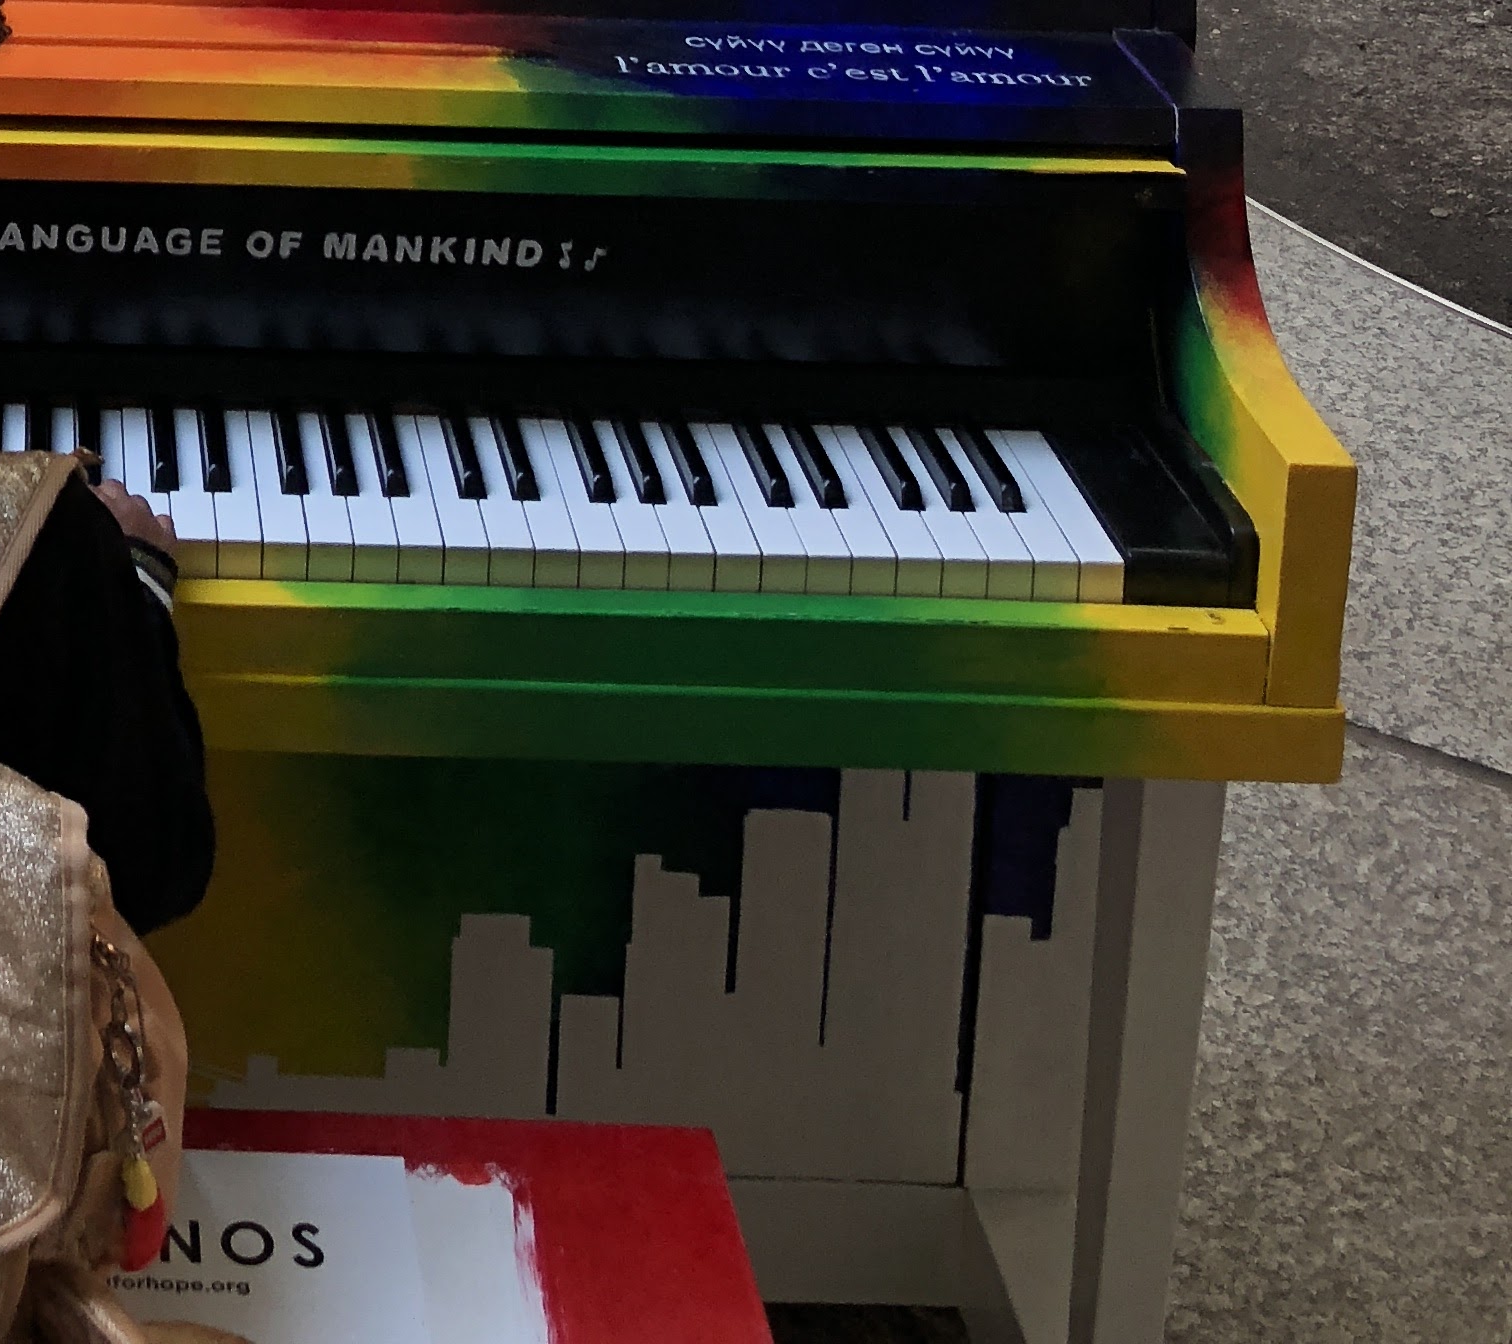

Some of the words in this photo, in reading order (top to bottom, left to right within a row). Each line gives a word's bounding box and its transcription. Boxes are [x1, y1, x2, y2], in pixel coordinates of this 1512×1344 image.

[617, 53, 793, 80] l'amour
[807, 61, 909, 84] c'est
[916, 63, 1093, 89] l'amour
[245, 229, 302, 260] OF
[323, 231, 544, 268] MANKIND
[159, 1218, 326, 1269] NOS
[106, 1274, 251, 1297] forhope.org
